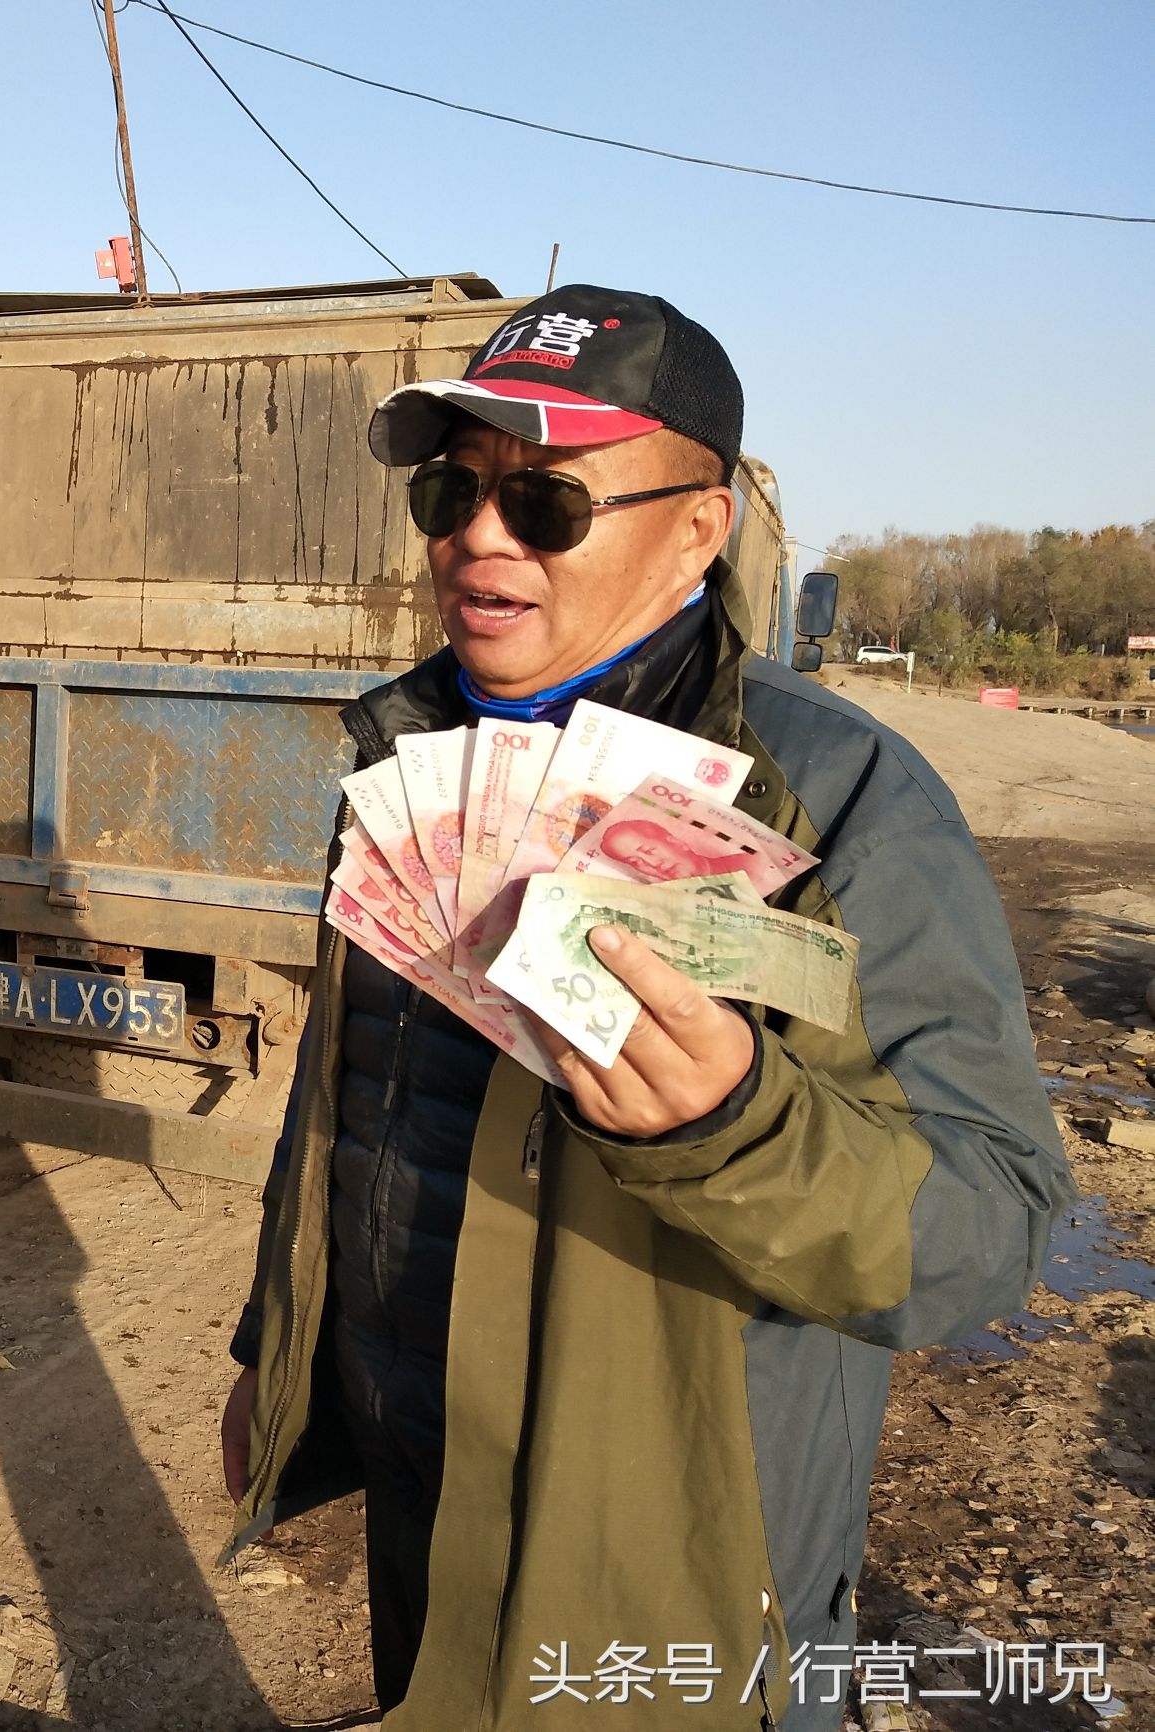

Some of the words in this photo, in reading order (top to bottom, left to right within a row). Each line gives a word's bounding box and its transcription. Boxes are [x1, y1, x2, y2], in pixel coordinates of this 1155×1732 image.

[482, 312, 598, 363] 行营
[491, 731, 533, 751] 100
[651, 784, 697, 809] 100
[335, 903, 364, 926] 100
[695, 903, 746, 919] ZHONGGUO
[748, 913, 784, 928] RENMIN
[824, 937, 845, 962] 50
[430, 980, 460, 1005] YUAN
[551, 972, 597, 1007] 50
